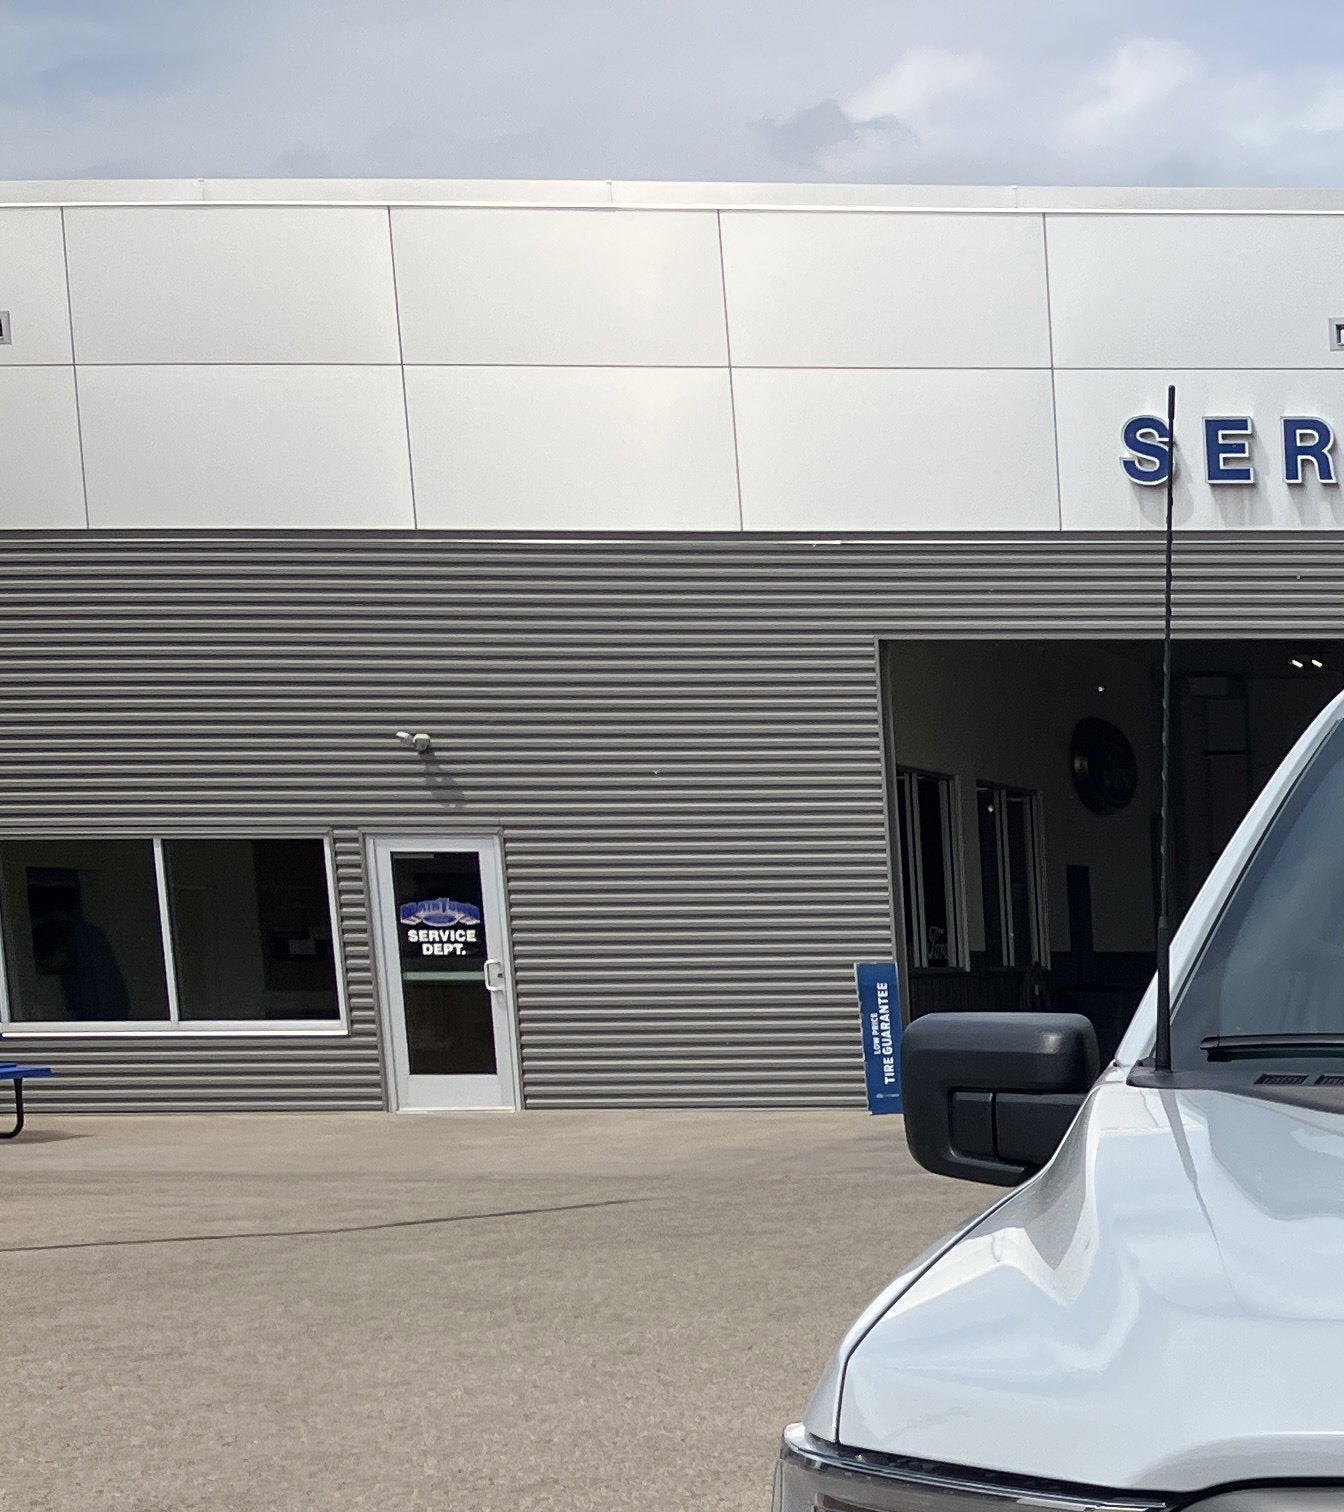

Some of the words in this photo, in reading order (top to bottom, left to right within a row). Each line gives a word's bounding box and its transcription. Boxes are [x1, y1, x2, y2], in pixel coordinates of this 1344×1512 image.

[408, 929, 477, 942] SERVICE
[422, 943, 466, 955] DEPT.
[876, 982, 893, 1055] GUARANTEE
[873, 1036, 881, 1055] LOW
[883, 1056, 896, 1085] TIRE
